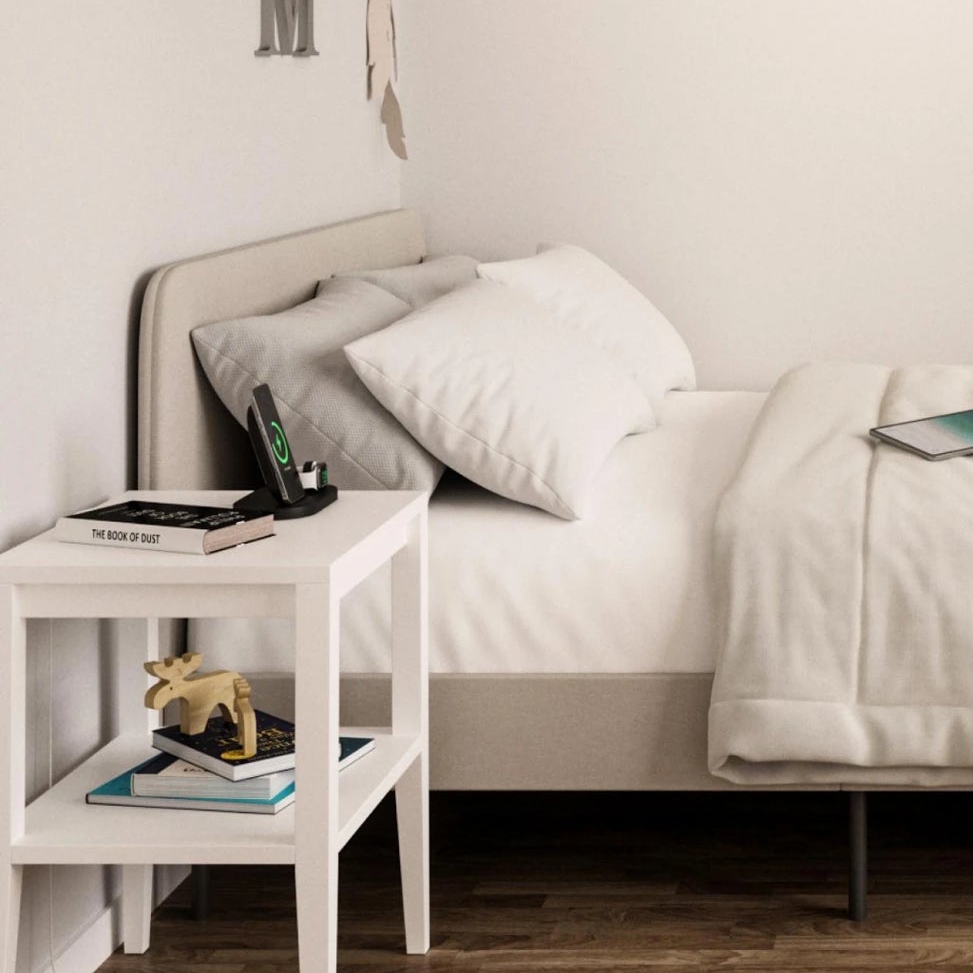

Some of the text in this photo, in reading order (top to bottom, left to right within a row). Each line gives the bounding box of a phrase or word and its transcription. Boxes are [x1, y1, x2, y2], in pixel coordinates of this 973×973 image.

[92, 528, 161, 544] THE BOOK OF DUST
